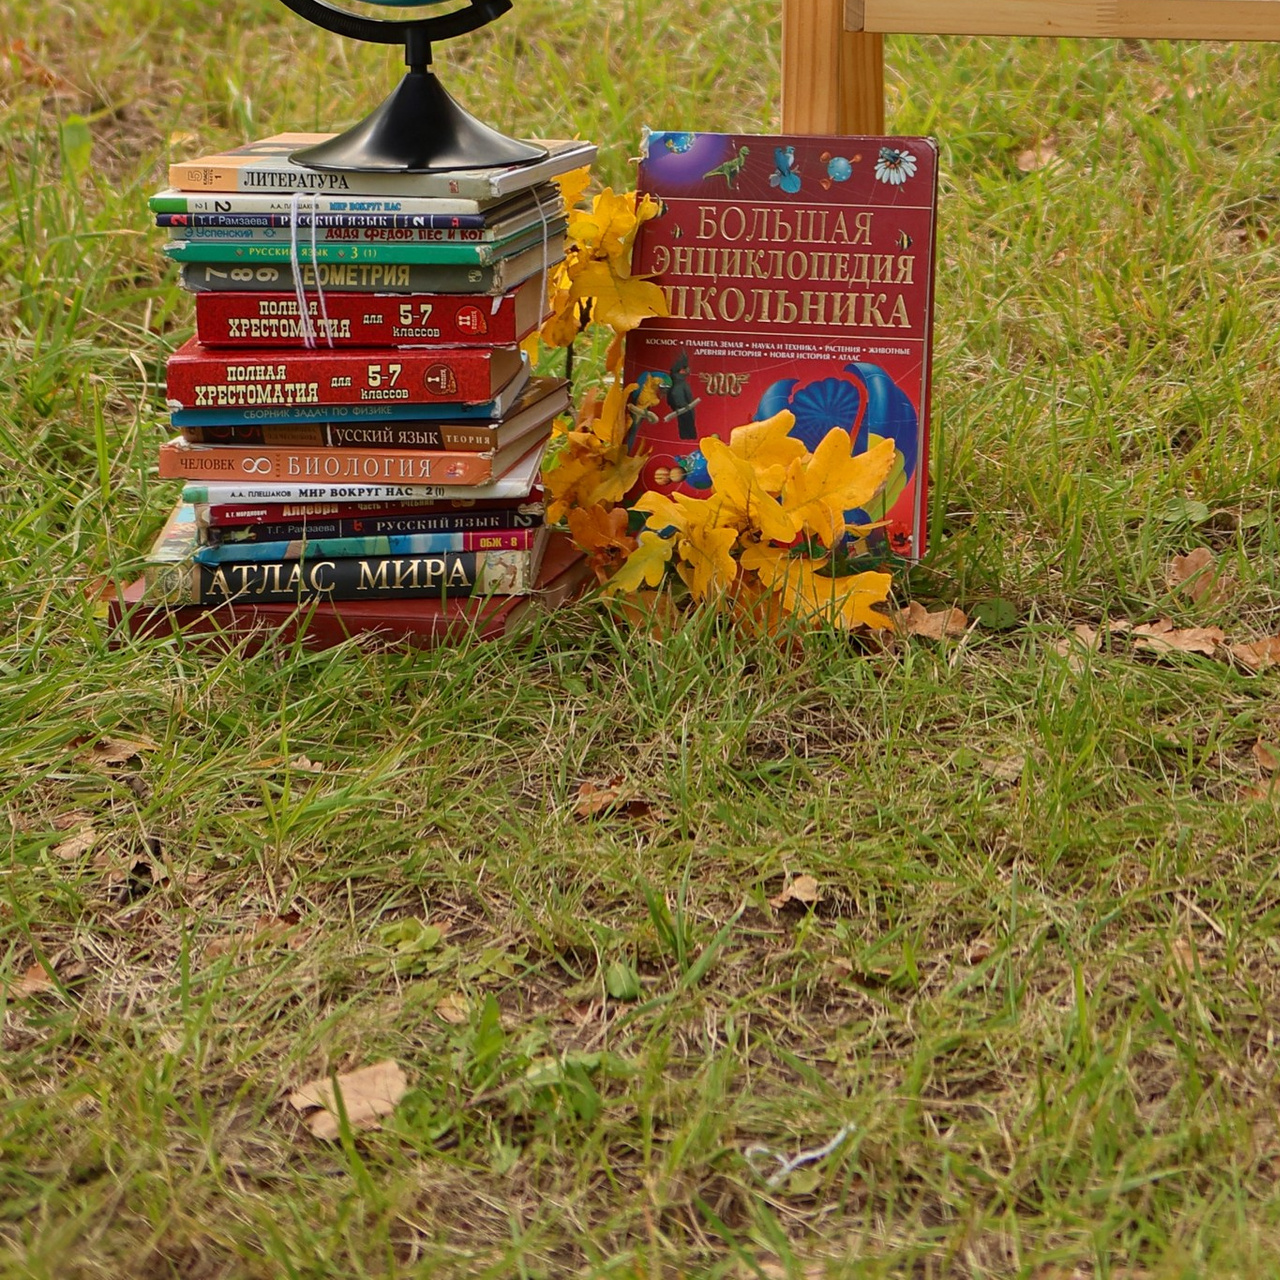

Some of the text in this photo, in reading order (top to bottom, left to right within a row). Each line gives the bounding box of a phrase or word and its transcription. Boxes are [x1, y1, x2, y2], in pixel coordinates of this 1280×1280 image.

[243, 171, 350, 190] ЛИТЕРАТУРА
[215, 201, 232, 212] 2
[329, 202, 402, 210] МИР ВОКРУГ НАС
[218, 216, 268, 226] Рамзаева
[280, 214, 388, 226] РССКИЙ ЯЗЫК
[412, 216, 424, 226] 2
[696, 206, 874, 246] БОЛЬШАЯ
[325, 228, 359, 240] ДЯДЯ
[418, 228, 443, 240] ПЕС
[447, 229, 456, 240] И
[460, 230, 484, 240] КОТ
[350, 246, 358, 259] 3
[651, 245, 915, 289] ЭНЦИКЛОПЕДИЯ
[205, 267, 228, 282] 7
[230, 268, 254, 282] 8
[259, 301, 318, 316] ПОЛНЯ
[363, 314, 384, 324] для
[400, 304, 433, 326] 5-7
[392, 326, 440, 338] классов
[685, 340, 718, 348] ПЛАНЕТА
[752, 342, 775, 350] НАУКА
[868, 347, 910, 355] ЖИВОТНЫЕ
[694, 348, 726, 356] ДРЕВНЯЯ
[728, 350, 762, 358] ИСТОРИЯ
[796, 352, 830, 360] ИСТОРИЯ
[226, 365, 286, 381] ПОЛНАЯ
[368, 364, 402, 387] 5-7
[330, 376, 352, 388] для
[195, 382, 319, 406] ХРЕСТОМАТИЯ
[360, 388, 409, 400] классов
[243, 406, 392, 418] СБОРНИК ЗАДАЧ ПО ФИЗИКЕ
[446, 436, 490, 445] ТЕОРИЯ
[180, 458, 235, 470] ЧЕЛОВЕК
[242, 456, 272, 474] 8
[288, 456, 432, 478] БИОЛОГИЯ
[248, 490, 292, 498] ПЛЕШАКОВ
[298, 488, 326, 498] МИР
[330, 488, 382, 498] ВОКРУГ
[386, 488, 413, 496] НАС
[426, 486, 432, 496] 2
[376, 516, 500, 532] РУССКИЙ ЯЗЫК
[514, 514, 532, 526] 2
[206, 557, 472, 595] АТЛАС МИРА
